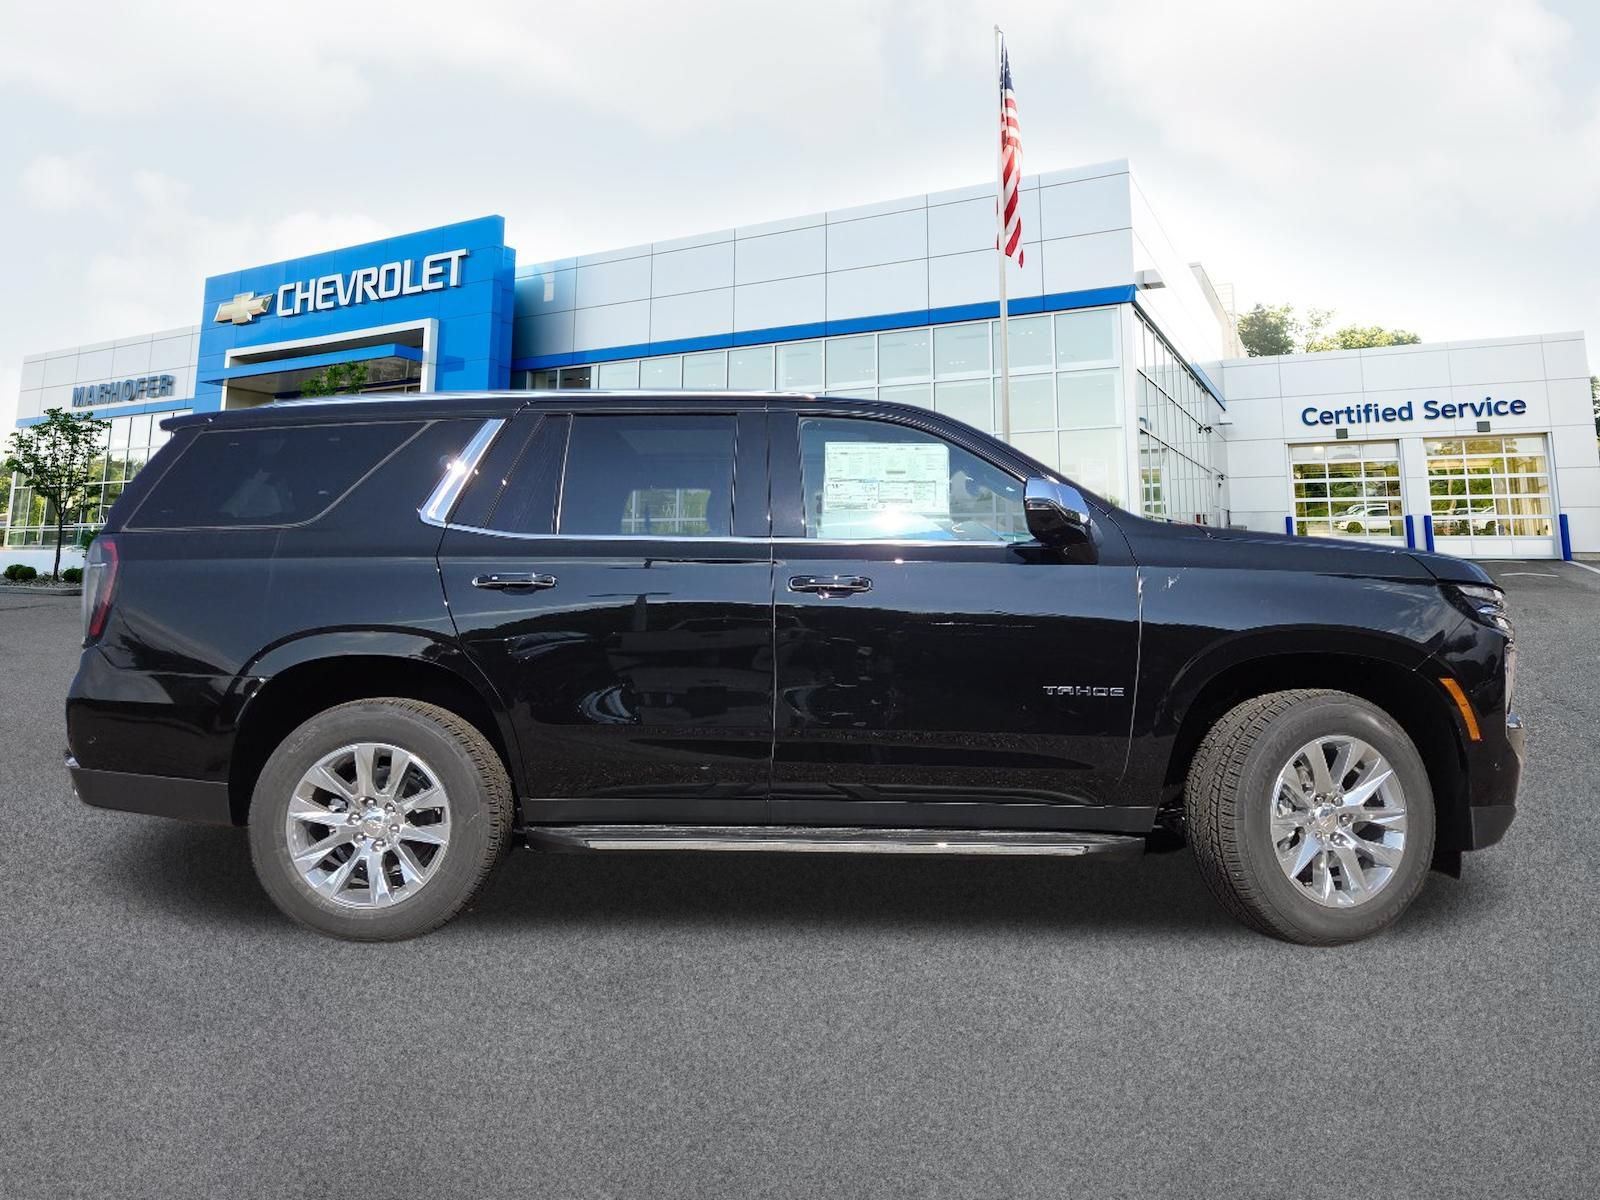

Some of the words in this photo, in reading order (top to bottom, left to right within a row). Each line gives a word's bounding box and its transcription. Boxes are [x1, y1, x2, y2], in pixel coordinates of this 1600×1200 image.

[276, 248, 469, 317] CHEVROLET
[72, 375, 175, 407] MARHOFER
[1301, 401, 1414, 426] Certified
[1423, 397, 1527, 420] Service
[1042, 685, 1125, 697] TAHOE
